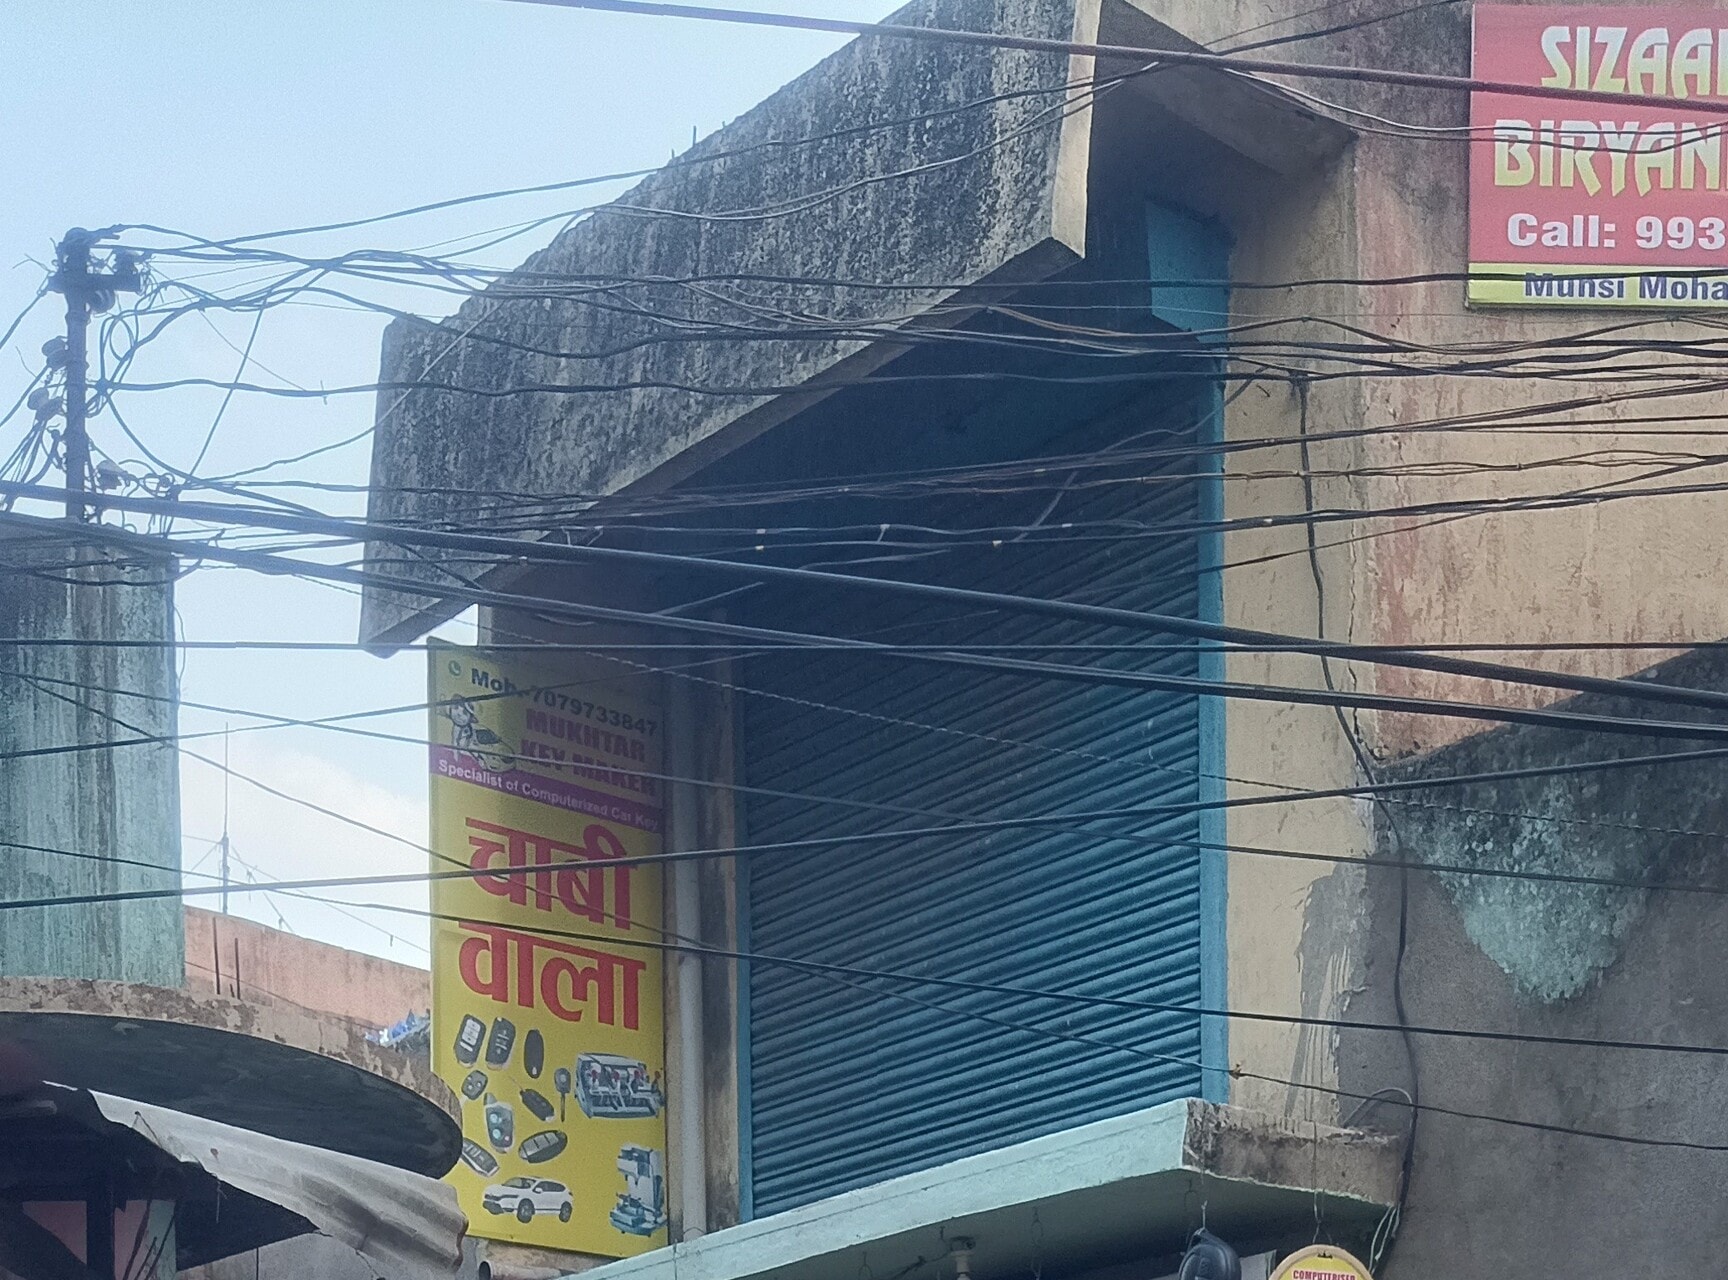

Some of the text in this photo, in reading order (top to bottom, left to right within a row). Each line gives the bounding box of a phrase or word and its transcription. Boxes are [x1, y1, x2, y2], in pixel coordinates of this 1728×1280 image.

[1494, 119, 1728, 197] BIRYAN
[1507, 213, 1727, 250] Call: 993
[521, 739, 658, 797] KEY MAKER
[526, 708, 646, 762] MUKHTAR
[438, 759, 659, 830] Specialist of Computerized Car Key
[465, 817, 639, 930] चाबी
[458, 921, 647, 1031] वाला
